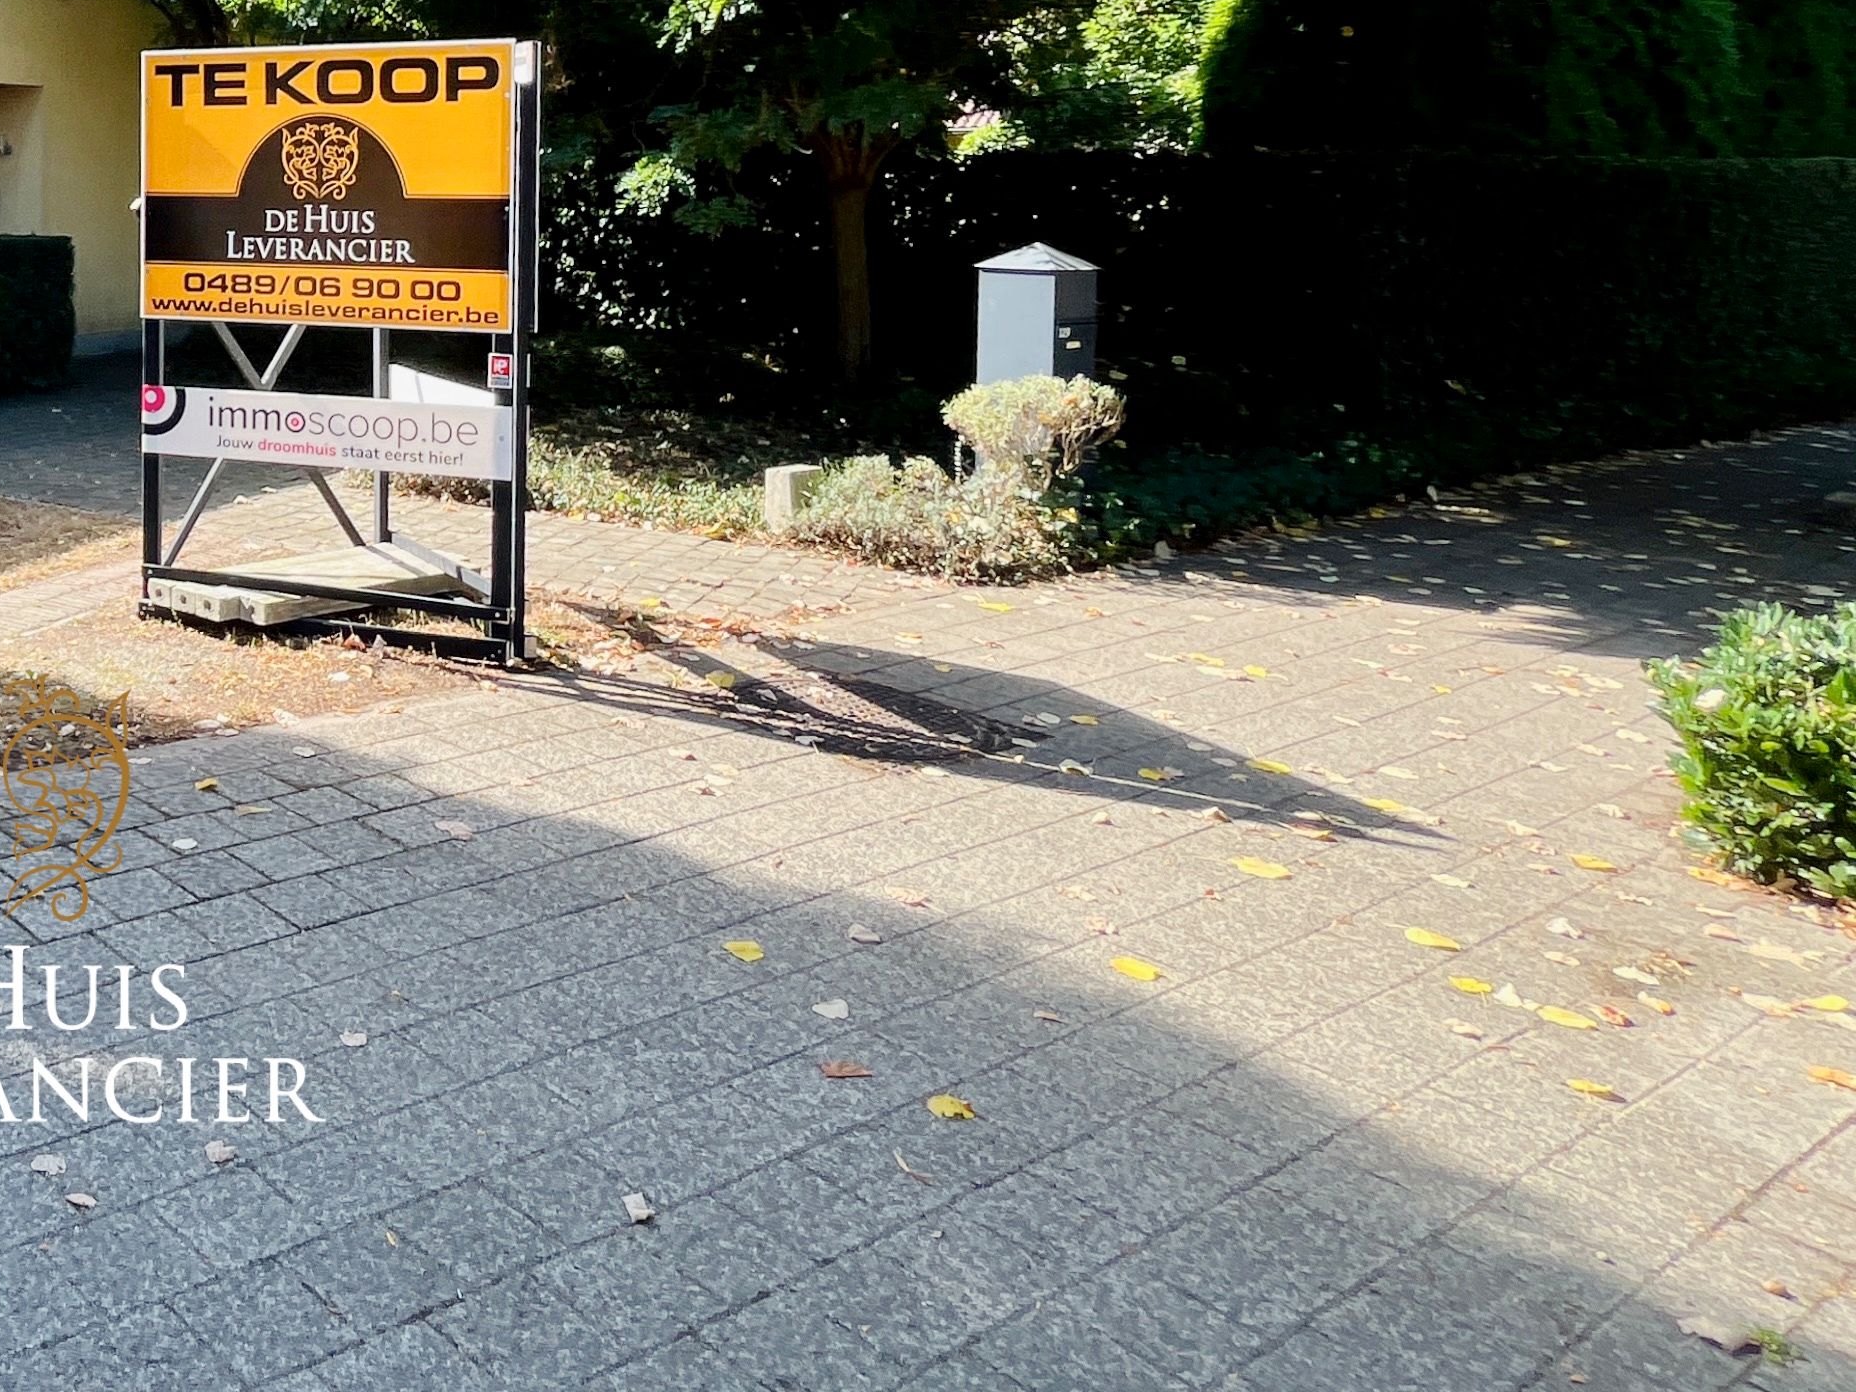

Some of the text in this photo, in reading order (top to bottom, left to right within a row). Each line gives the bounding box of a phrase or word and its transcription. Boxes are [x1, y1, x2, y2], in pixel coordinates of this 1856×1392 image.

[155, 56, 499, 107] TE KOOP
[264, 204, 375, 234] DE HUIS
[226, 231, 416, 264] LEVERANCIER
[183, 272, 461, 302] 0489/06 90 00
[152, 296, 500, 324] www.dehuisleverancier.be
[208, 396, 479, 449] immoscoop.be
[216, 435, 464, 466] Jouw droomhuis staat eerst hier!
